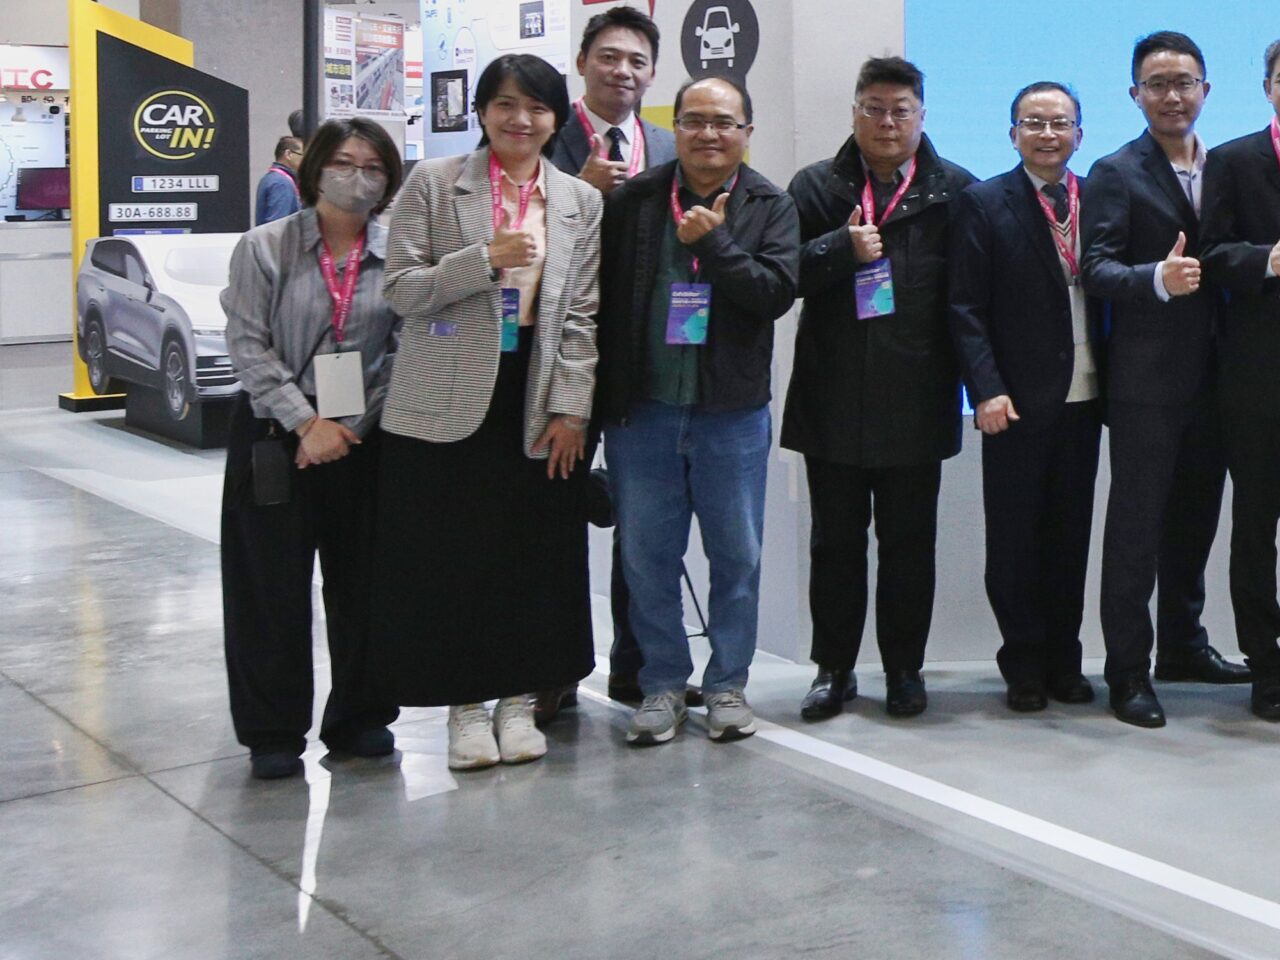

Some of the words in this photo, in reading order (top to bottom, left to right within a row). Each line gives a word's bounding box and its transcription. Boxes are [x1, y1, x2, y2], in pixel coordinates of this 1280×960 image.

[142, 103, 203, 127] CAR
[169, 127, 215, 149] IN!
[152, 178, 183, 189] 1234
[189, 178, 209, 189] LLL
[117, 206, 191, 219] 30A-688.88
